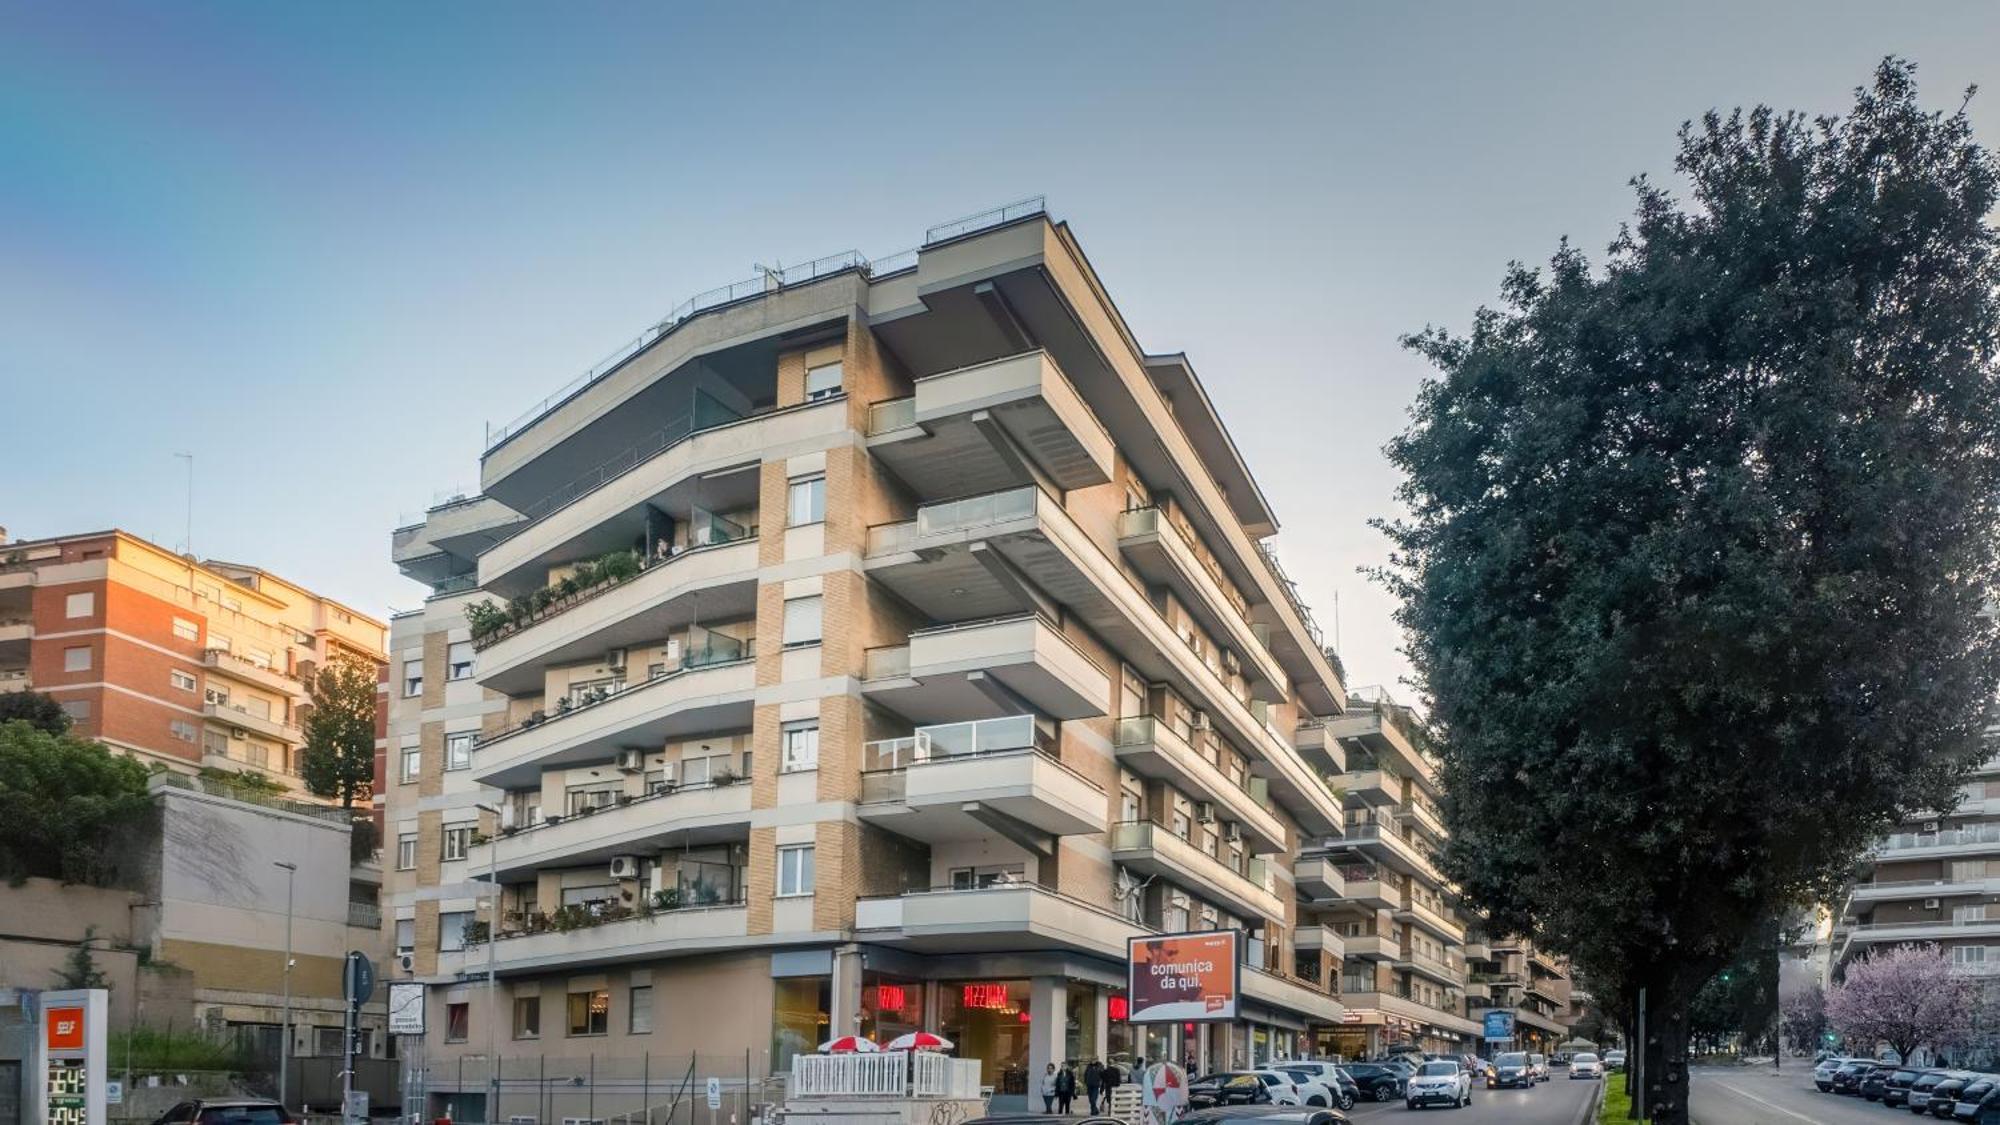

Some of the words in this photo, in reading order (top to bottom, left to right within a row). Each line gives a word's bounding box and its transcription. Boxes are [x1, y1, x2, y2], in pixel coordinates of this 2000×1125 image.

[1151, 959, 1213, 975] comunica
[1161, 976, 1176, 989] da
[1179, 974, 1202, 991] qui.
